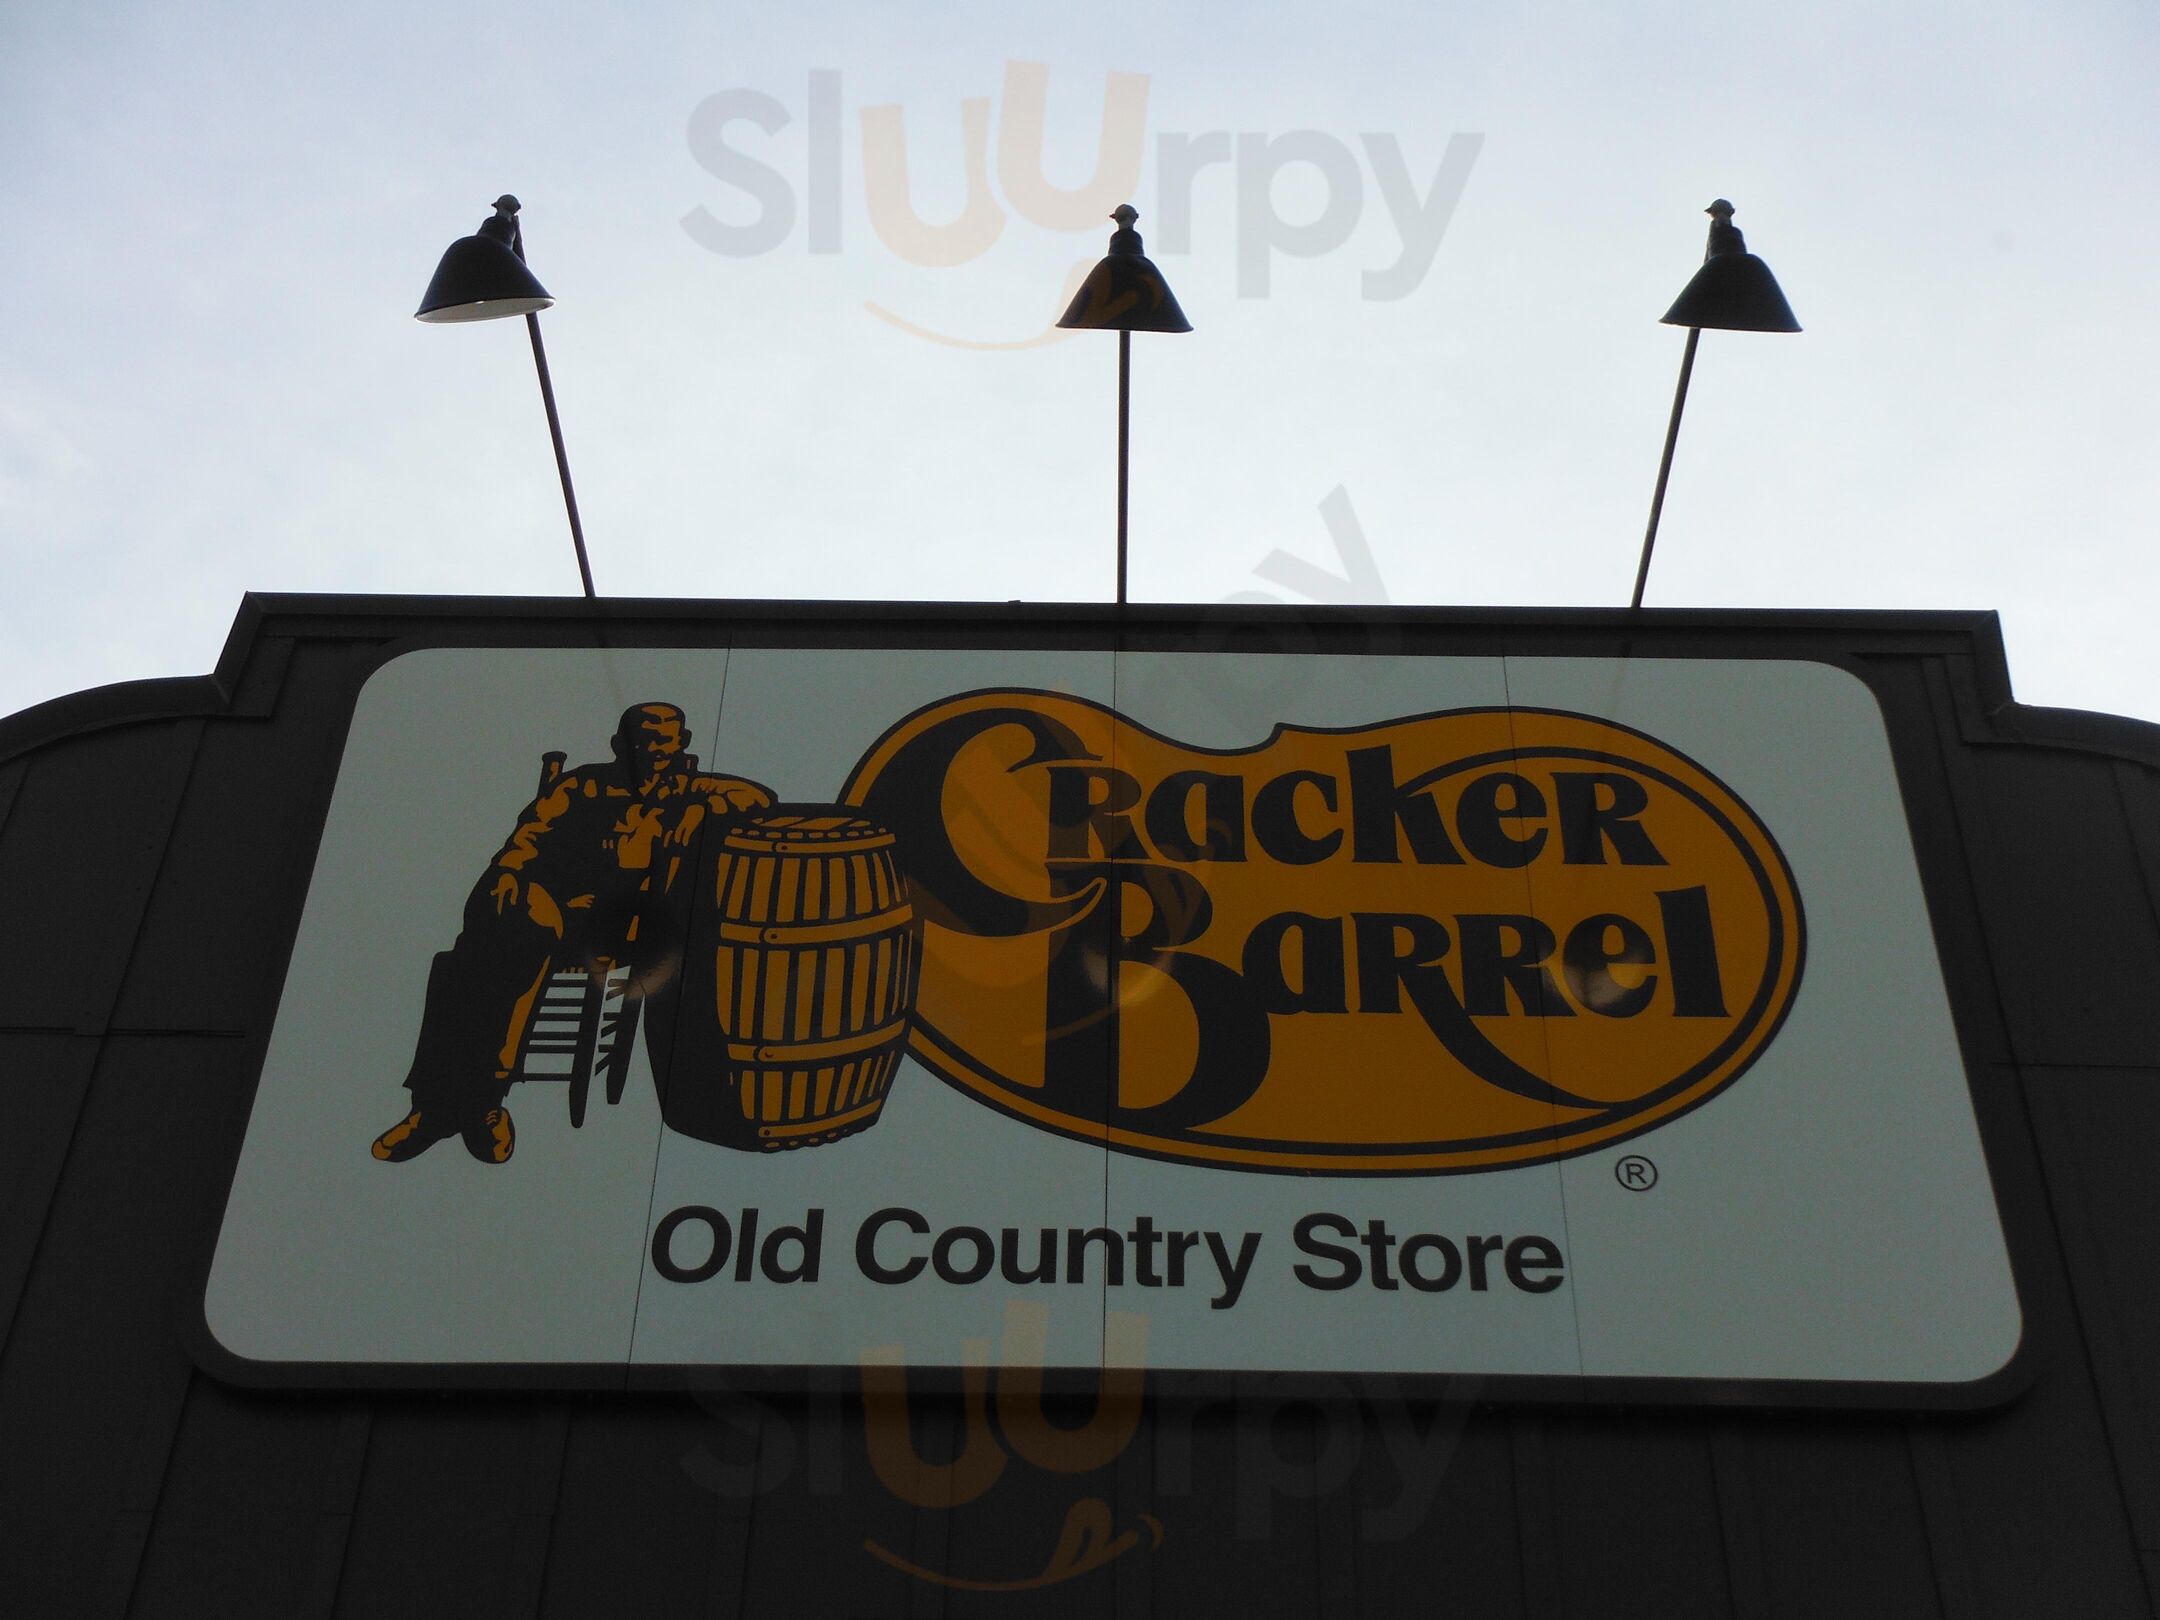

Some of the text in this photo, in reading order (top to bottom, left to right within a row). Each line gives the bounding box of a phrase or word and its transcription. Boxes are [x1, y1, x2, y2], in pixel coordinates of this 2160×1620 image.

[650, 1205, 1566, 1310] Old Country Store
